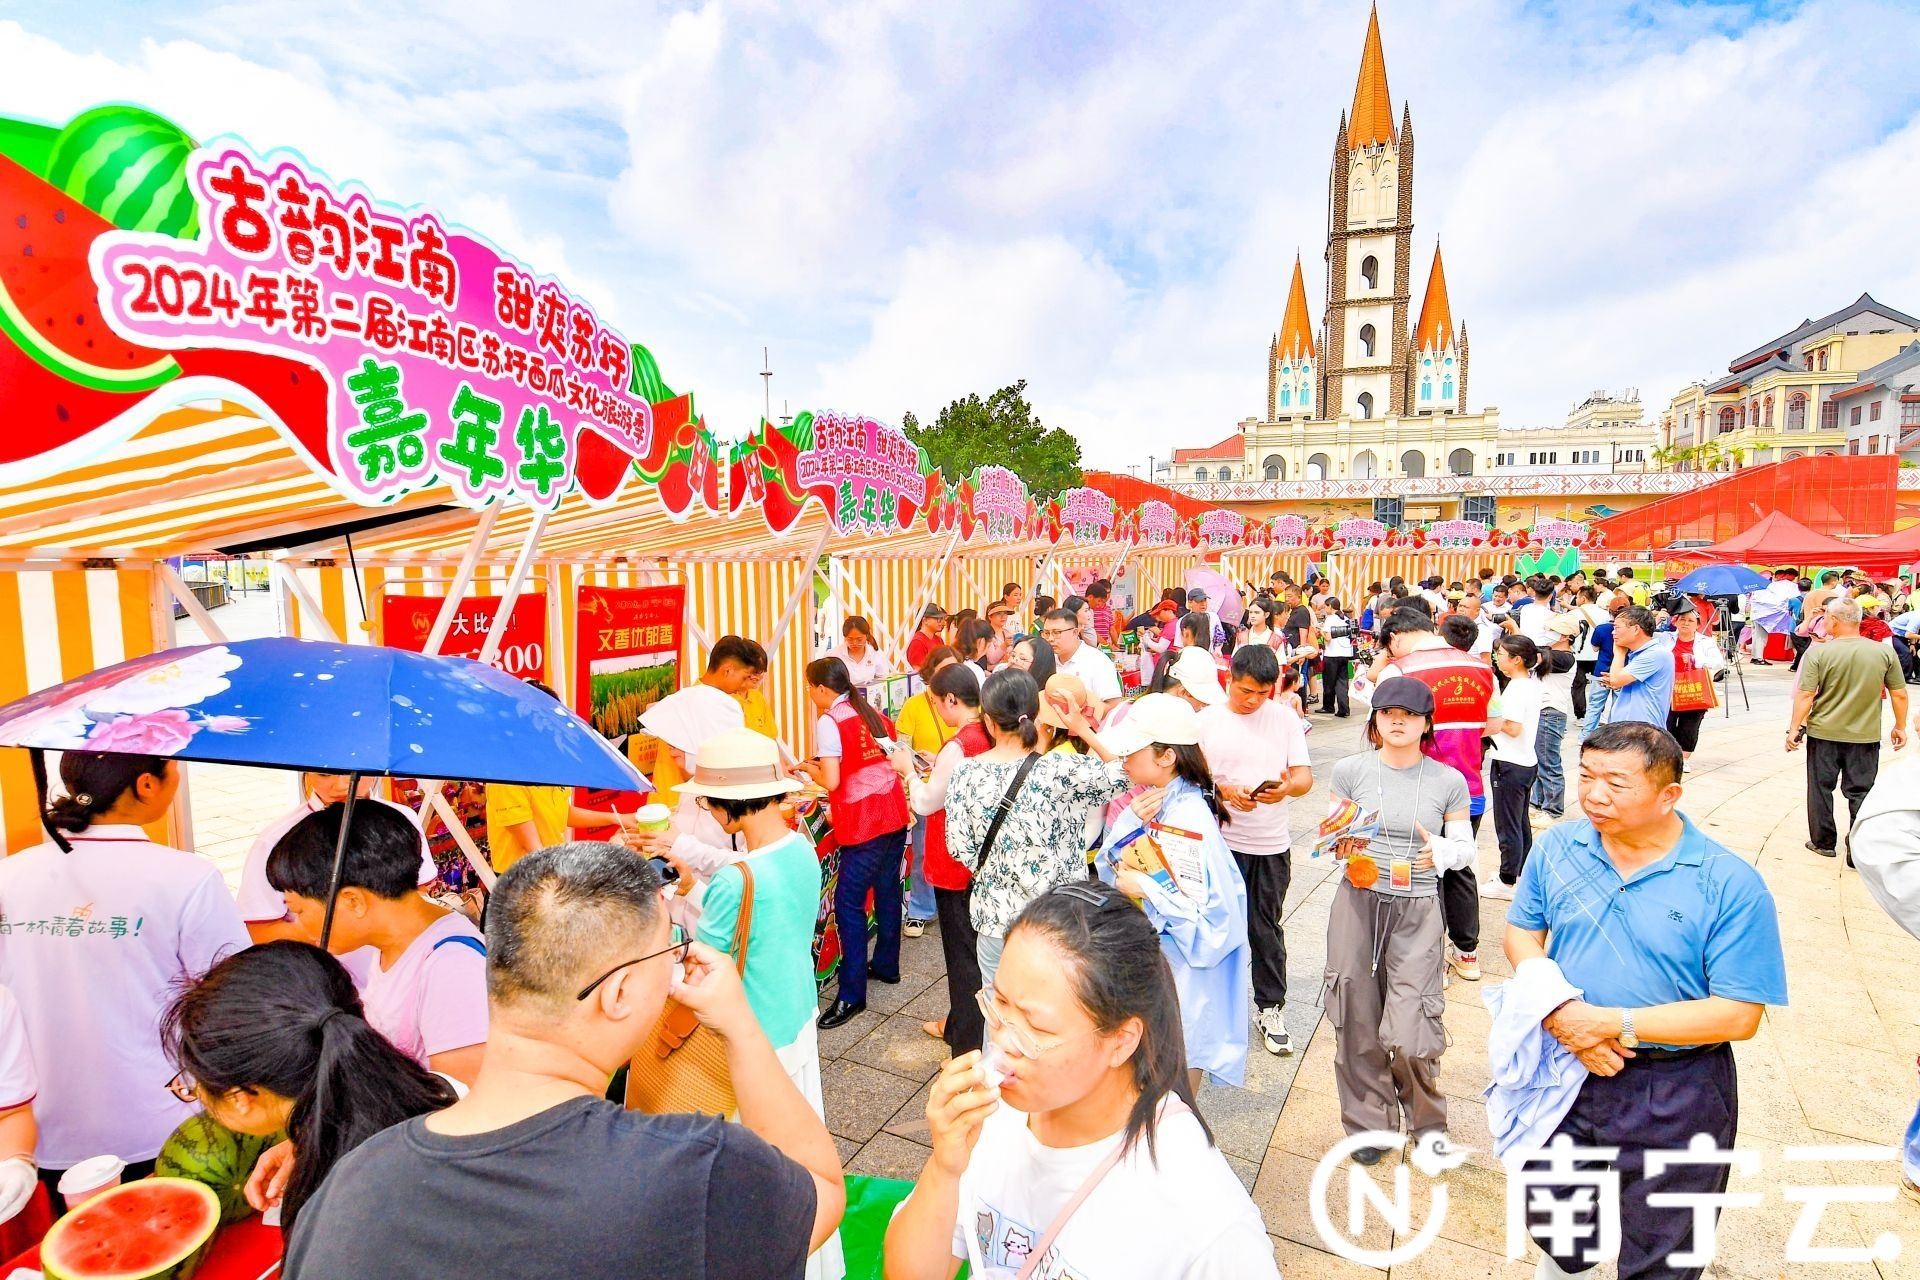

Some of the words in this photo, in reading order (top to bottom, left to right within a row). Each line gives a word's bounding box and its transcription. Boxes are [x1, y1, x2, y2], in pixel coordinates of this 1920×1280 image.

[211, 165, 457, 307] 古韵江南
[493, 266, 628, 386] 甜爽苏圩
[121, 261, 647, 447] 2024年第二届江南区苏圩西瓜文化旅游季
[346, 358, 567, 496] 嘉年华
[815, 419, 867, 453] 古韵江南
[876, 430, 917, 473] 甜爽苏圩
[838, 479, 895, 528] 嘉年华
[598, 623, 673, 652] 又香优郁香
